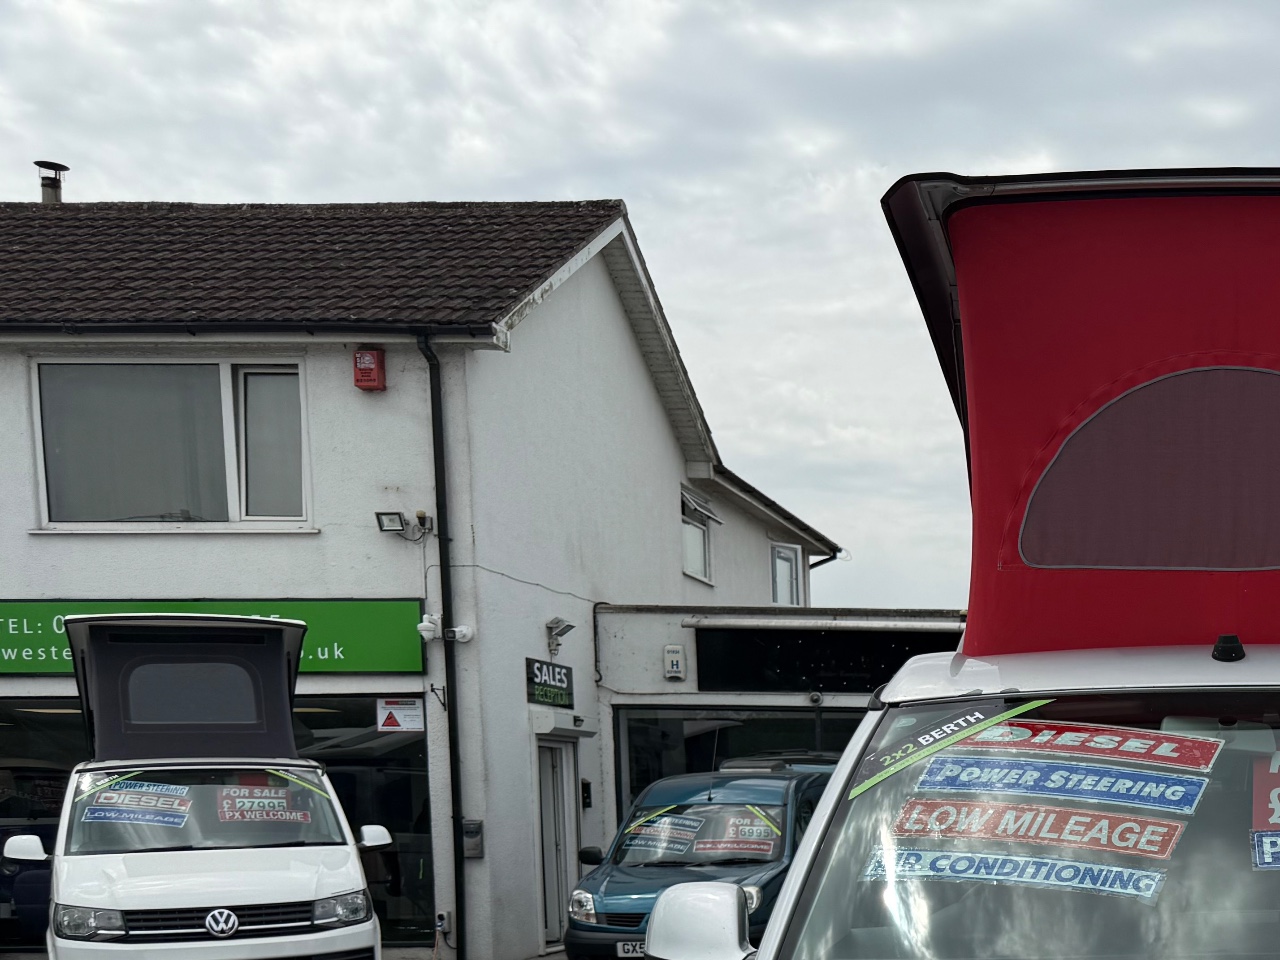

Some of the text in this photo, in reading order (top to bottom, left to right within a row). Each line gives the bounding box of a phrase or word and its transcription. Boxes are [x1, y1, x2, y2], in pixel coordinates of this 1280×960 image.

[671, 659, 679, 669] H
[533, 662, 568, 689] SALES
[534, 684, 569, 705] RECEPTION
[879, 711, 985, 767] 2x2 BERTH
[973, 725, 1181, 758] DIESEL
[113, 781, 186, 796] POWER STEERING
[934, 764, 1186, 801] POWER STEERING
[98, 792, 187, 810] DIESEL
[222, 788, 287, 798] FOR SALE
[237, 801, 287, 811] 27995
[122, 814, 184, 824] MILEAGE
[225, 811, 305, 821] PX WELCOME
[740, 828, 770, 837] 6995
[905, 804, 1168, 851] LOW MILEAGE
[928, 854, 1157, 893] CONDITIONING
